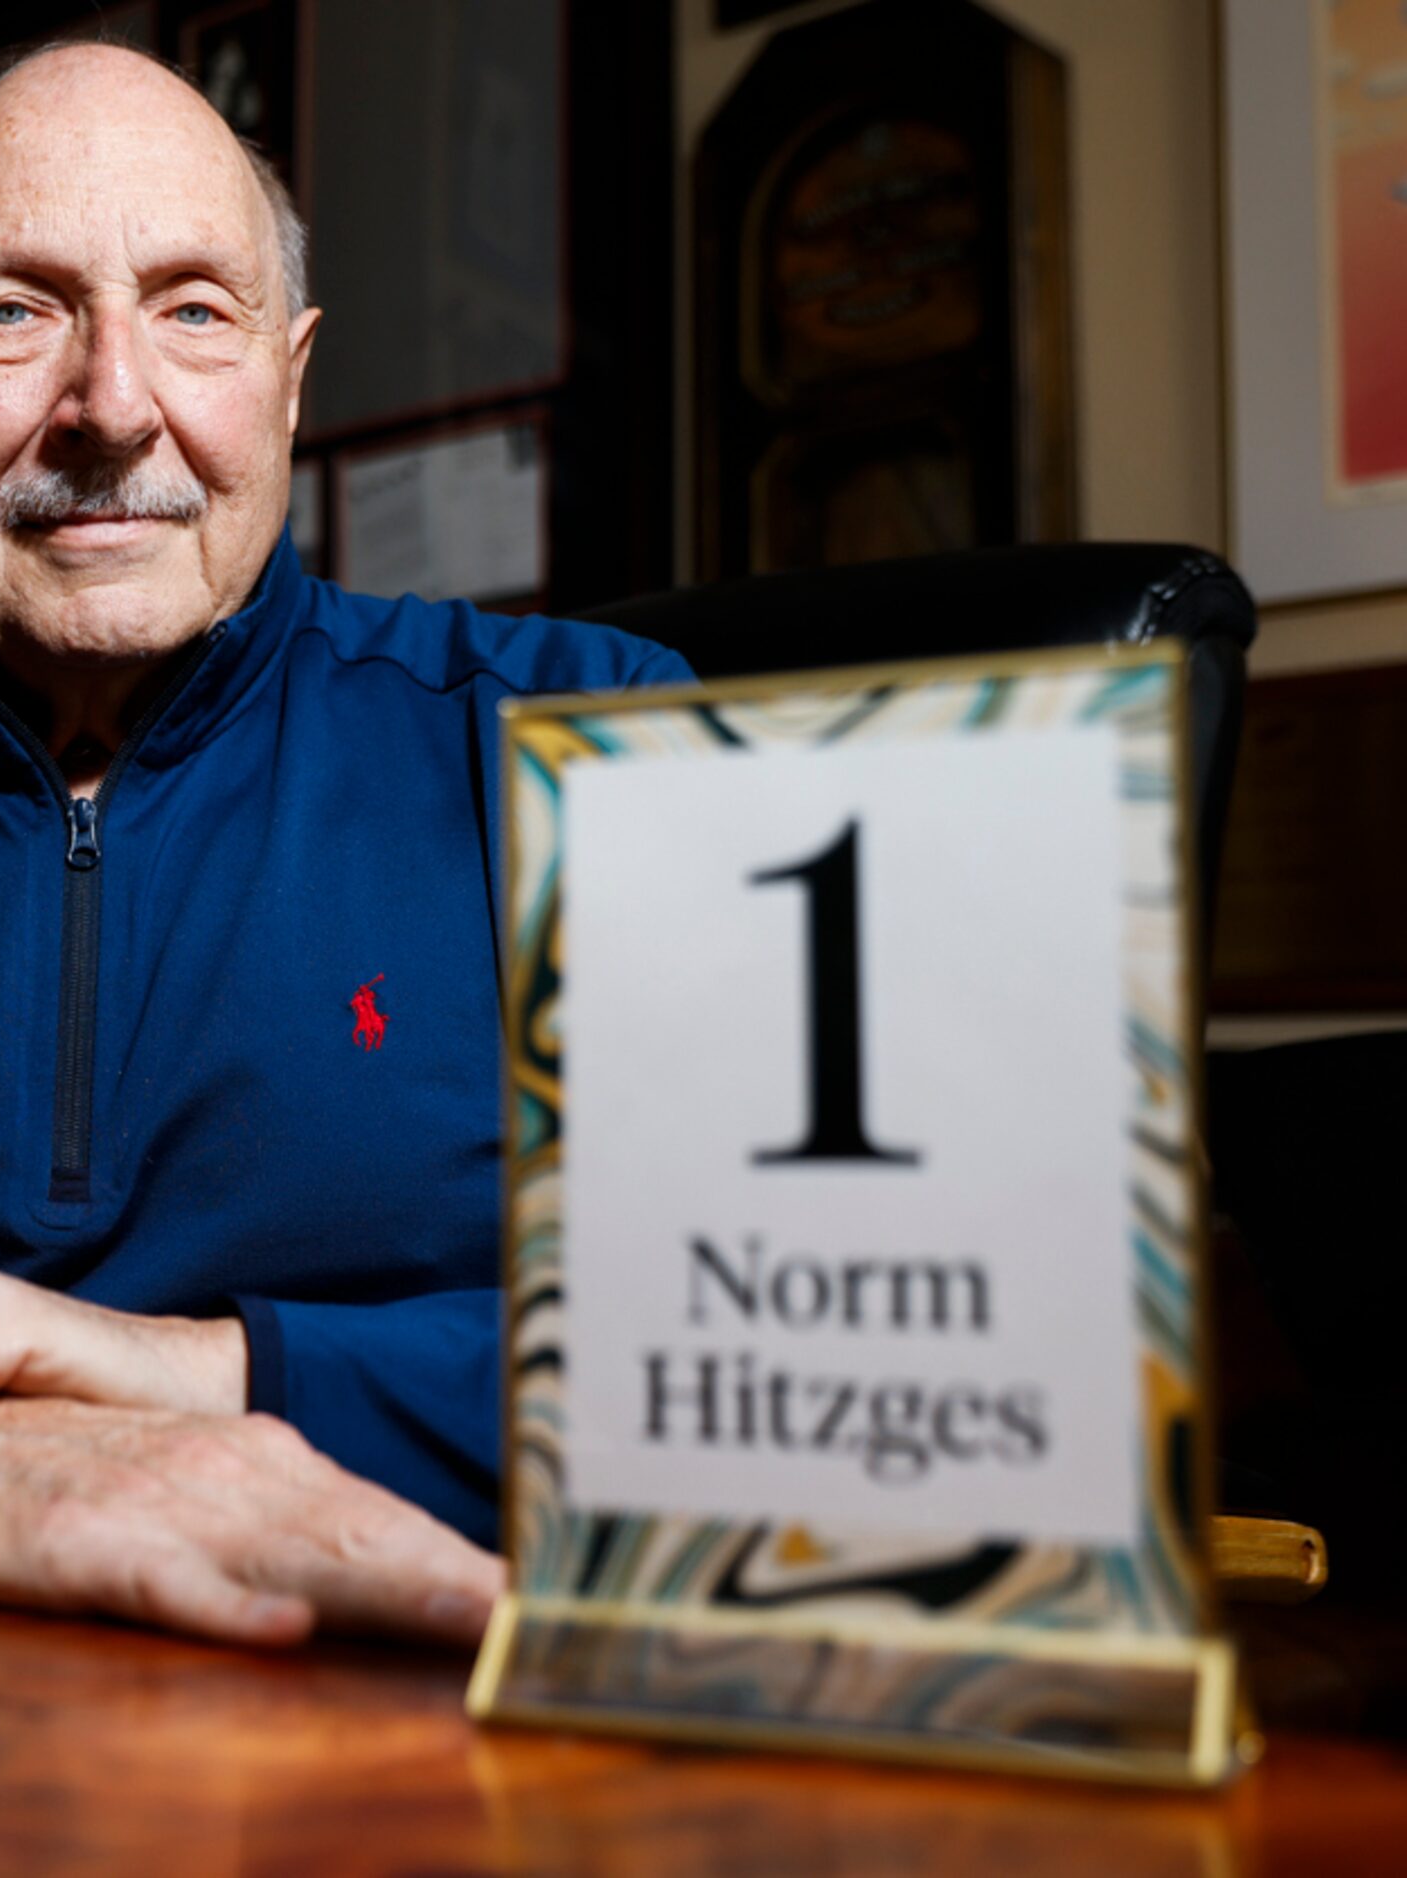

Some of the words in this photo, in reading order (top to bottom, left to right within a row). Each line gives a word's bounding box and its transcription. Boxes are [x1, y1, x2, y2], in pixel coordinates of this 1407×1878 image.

[750, 816, 921, 1168] 1
[688, 1236, 990, 1332] Norm
[643, 1350, 1049, 1480] Hitzges
